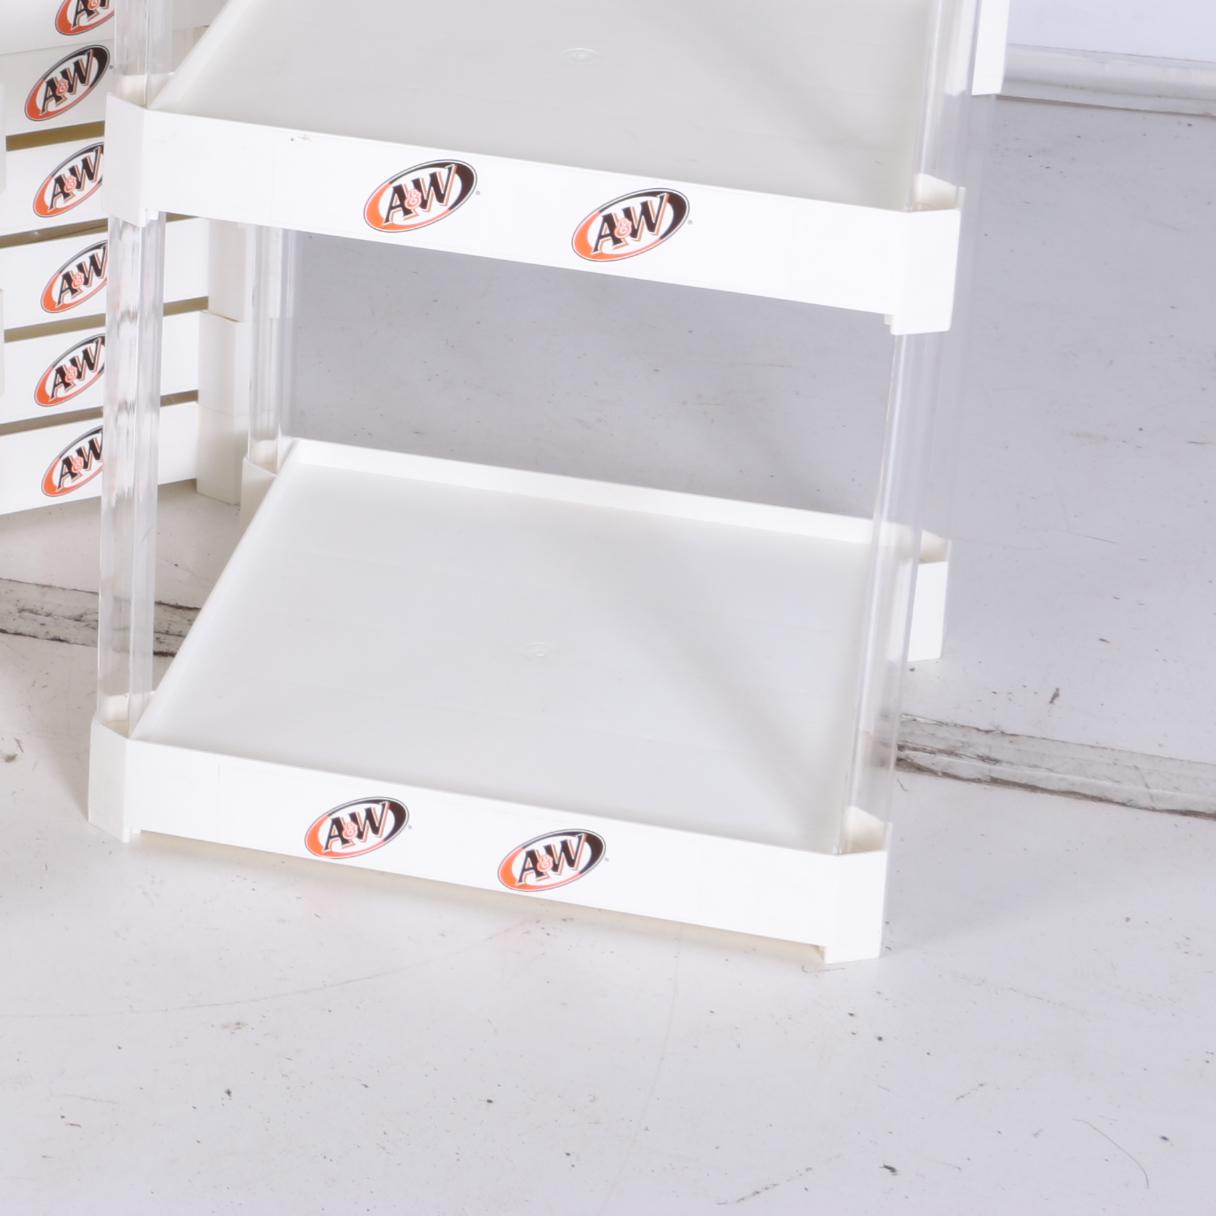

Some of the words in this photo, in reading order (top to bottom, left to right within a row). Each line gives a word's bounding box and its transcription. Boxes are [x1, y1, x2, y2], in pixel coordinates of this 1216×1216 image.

[40, 48, 94, 116] A&W
[48, 145, 102, 212] A&W
[382, 163, 457, 226] A&W
[591, 192, 669, 255] A&W
[56, 242, 107, 308] A&W
[49, 336, 101, 402] A&W
[322, 801, 390, 853] A&W
[516, 833, 587, 885] A&W
